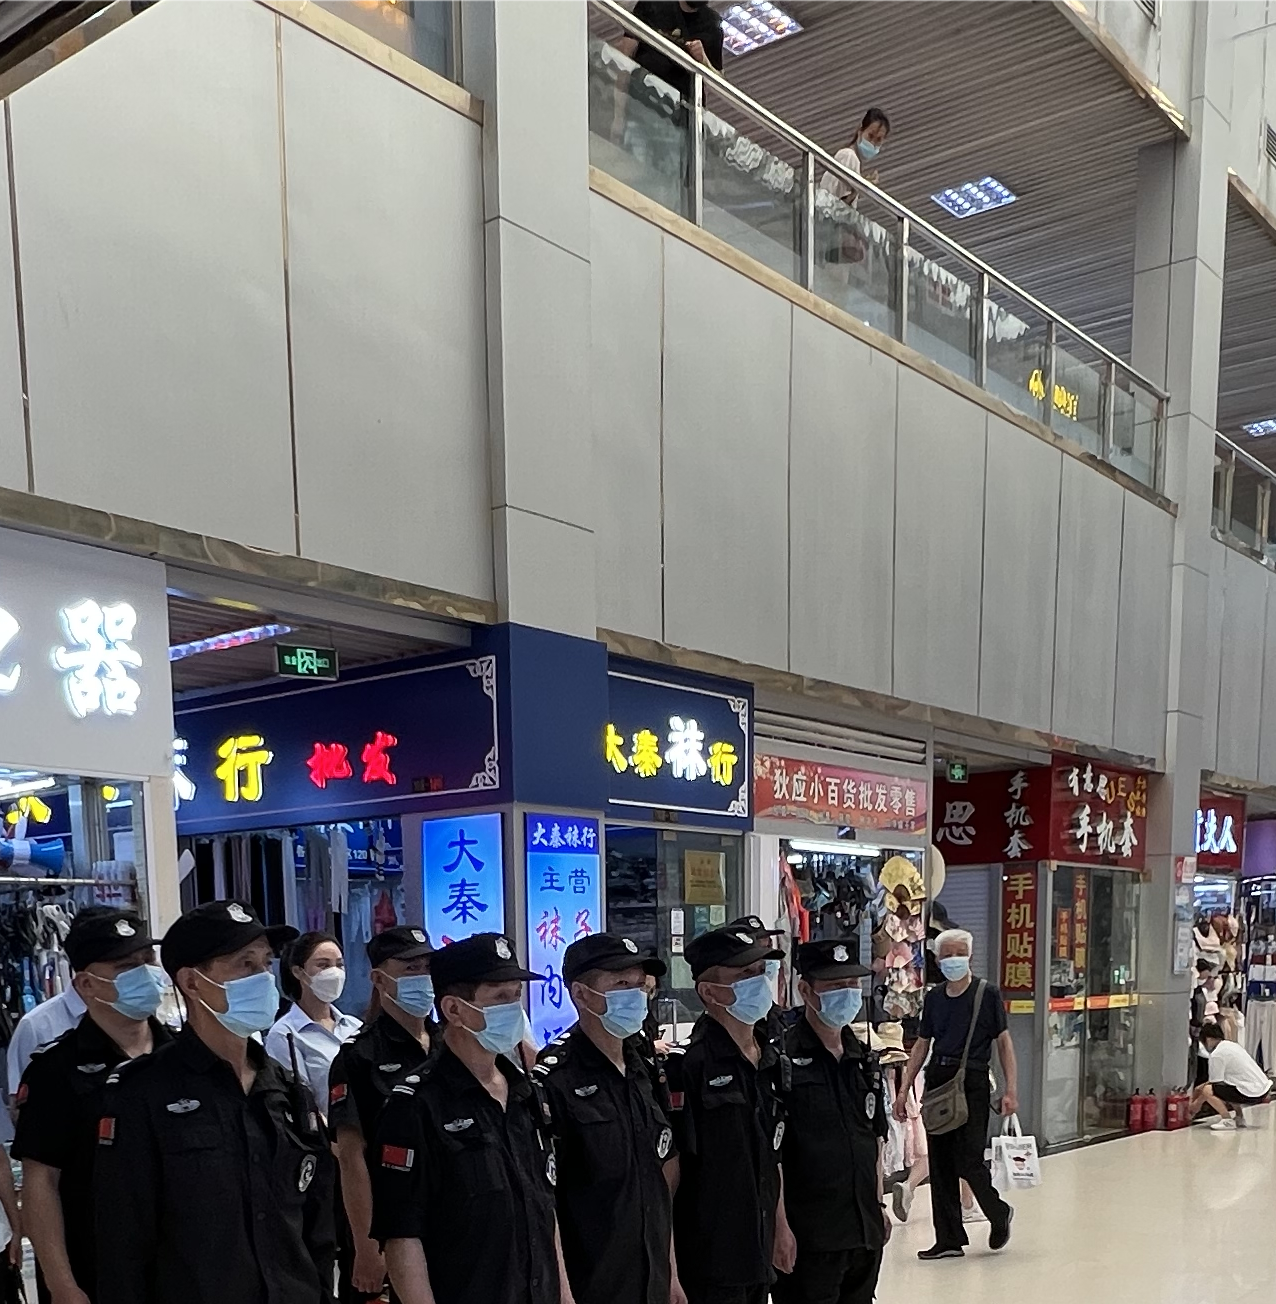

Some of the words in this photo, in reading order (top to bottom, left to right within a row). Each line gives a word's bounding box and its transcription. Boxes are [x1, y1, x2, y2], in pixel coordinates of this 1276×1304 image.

[306, 731, 397, 788] 批发
[603, 714, 738, 786] 大秦袜行
[773, 768, 917, 817] 狄应小百货批发零售
[1003, 770, 1033, 858] 手机套
[531, 822, 598, 849] 大秦袜行
[936, 801, 976, 845] 思
[442, 829, 490, 945] 大秦
[540, 866, 592, 894] 主营
[1004, 872, 1035, 988] 手机贴膜
